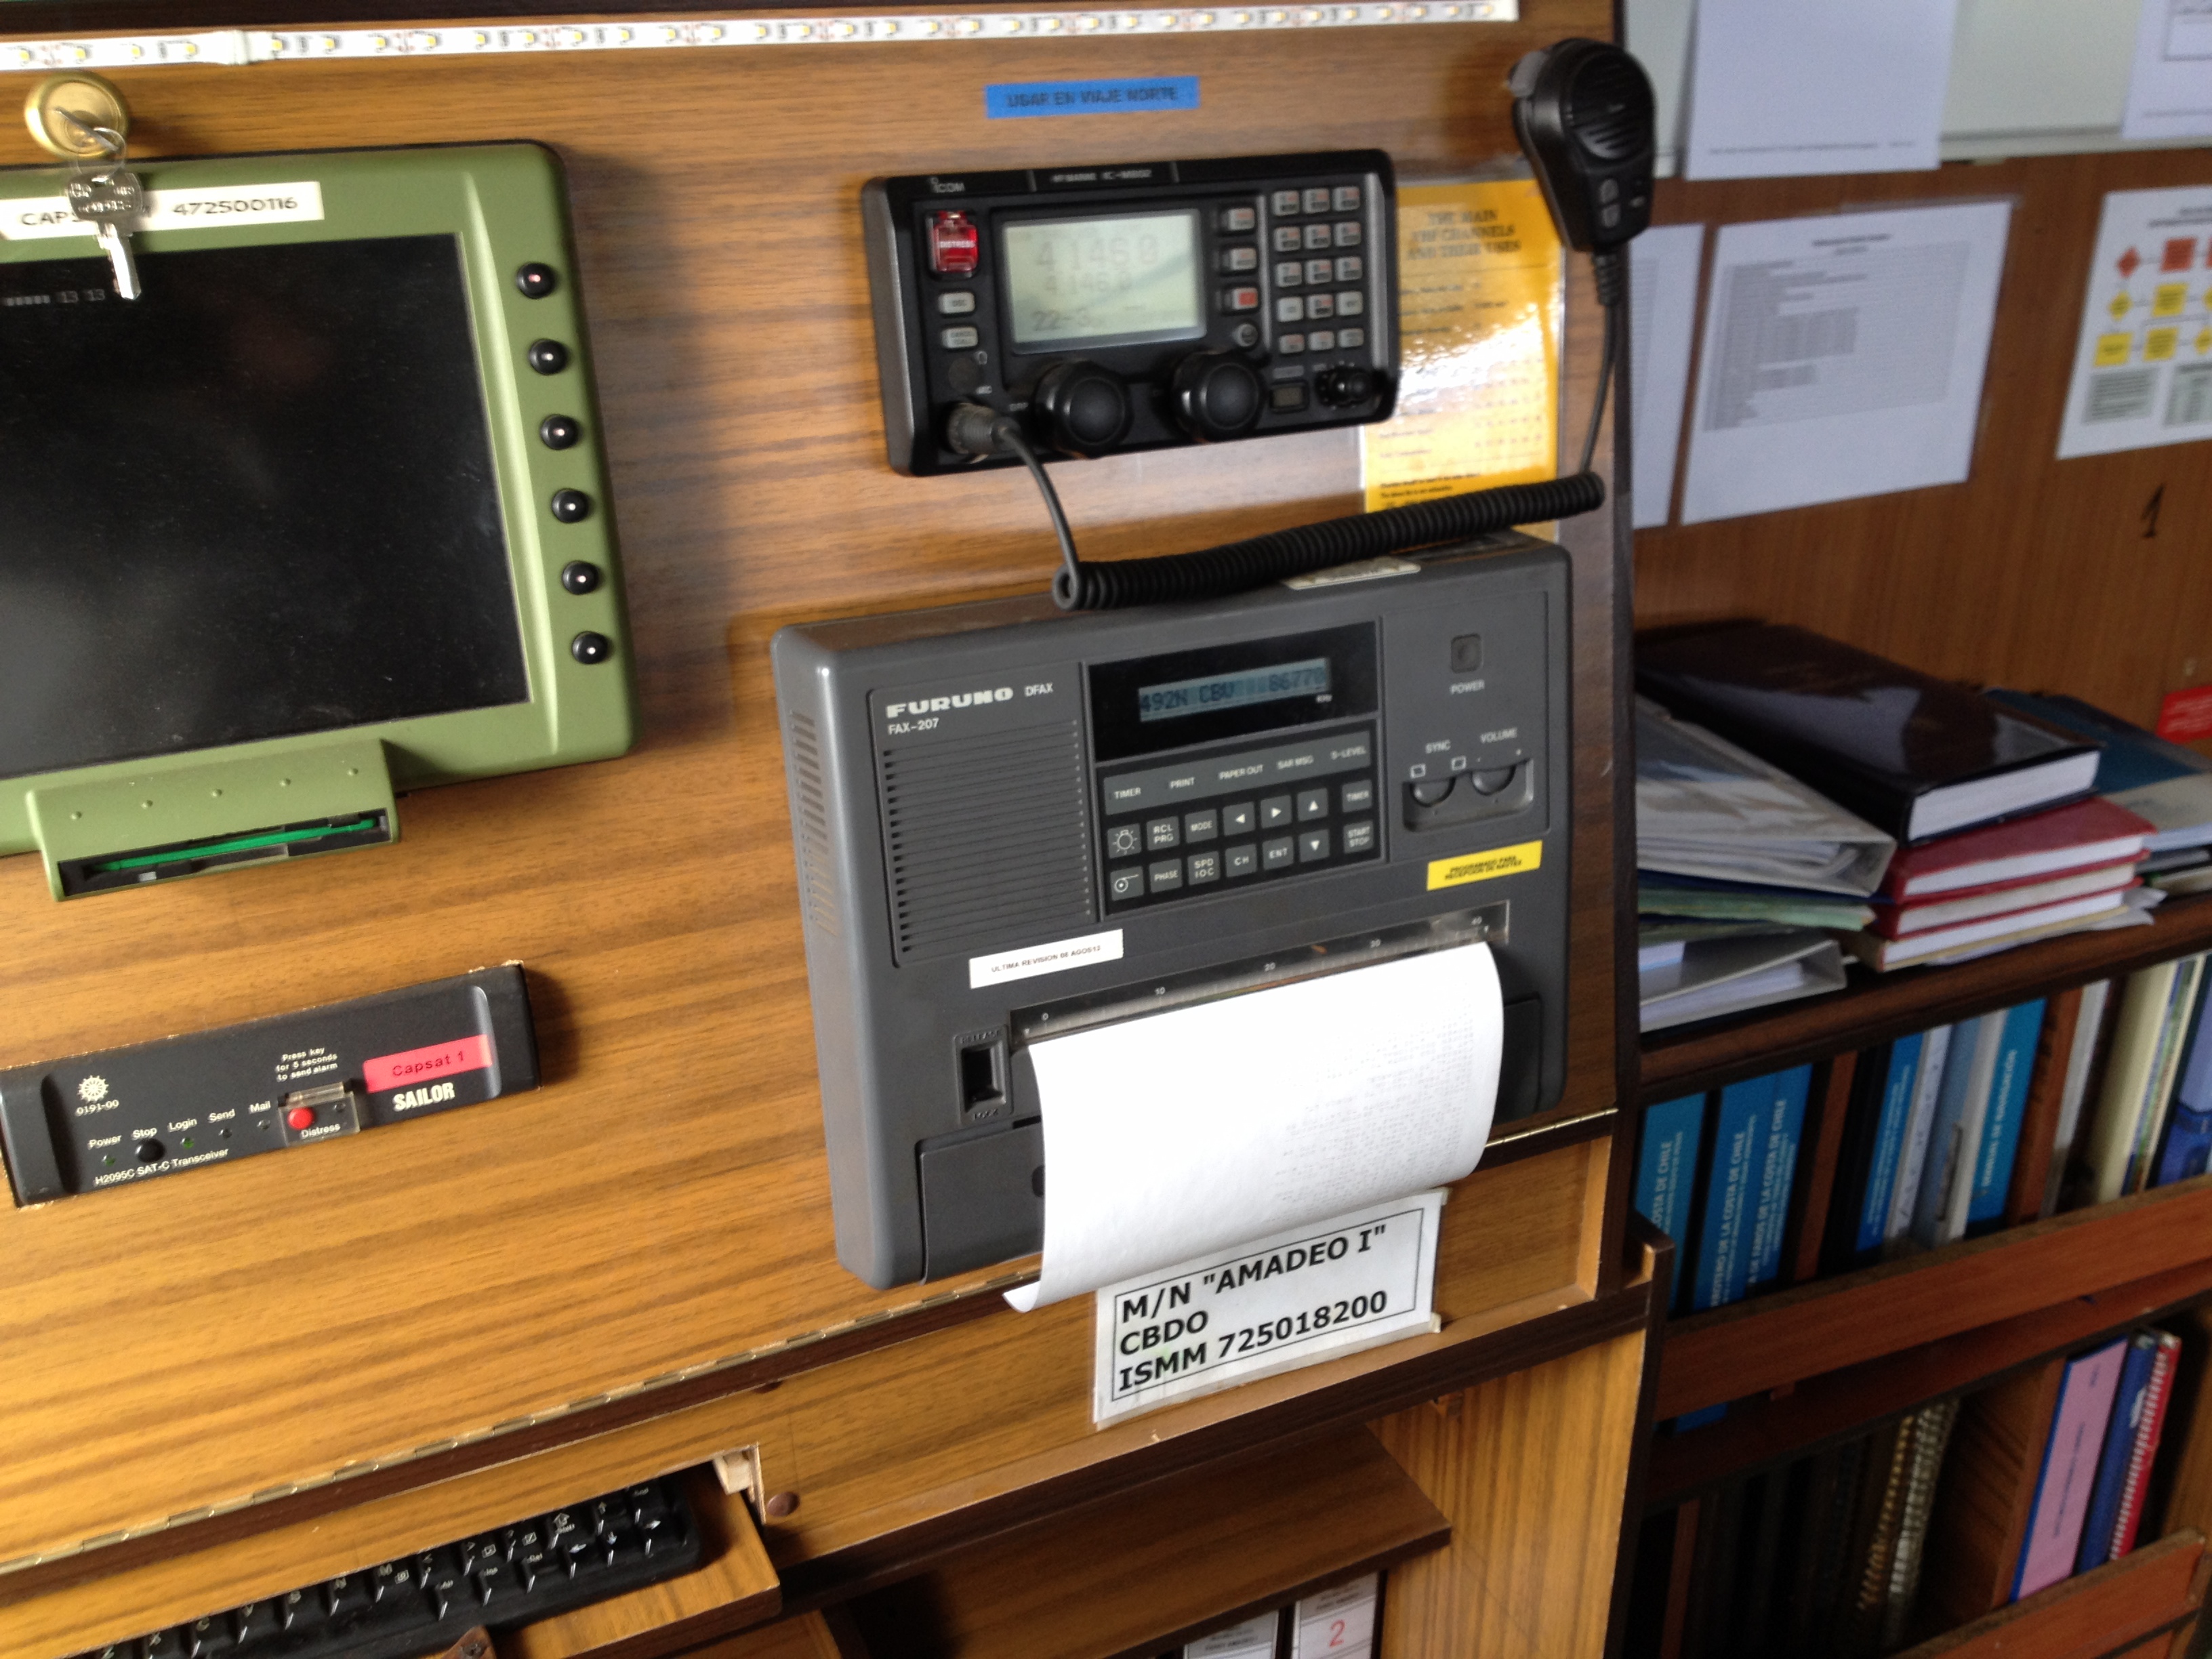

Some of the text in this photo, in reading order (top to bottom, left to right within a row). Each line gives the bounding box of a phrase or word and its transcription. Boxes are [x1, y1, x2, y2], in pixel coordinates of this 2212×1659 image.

[173, 197, 300, 216] 472500116
[1450, 680, 1485, 695] POWER
[885, 682, 1054, 718] FURUNO DFAX
[888, 718, 939, 735] FAX-207
[1480, 726, 1517, 743] VOLUME
[1330, 745, 1367, 760] S-LEVEL
[1426, 740, 1451, 754] SYNC
[1277, 756, 1314, 770] SAR MSG
[1219, 764, 1263, 780] PAPER OUT
[1169, 777, 1195, 790] PRINT
[1113, 787, 1141, 799] TIMER
[1347, 791, 1370, 802] TIMER
[1153, 824, 1173, 834] RCL
[1190, 821, 1213, 832] MODE
[1348, 826, 1370, 838] START
[1154, 833, 1174, 843] PRG
[1349, 836, 1370, 848] STOP
[1233, 856, 1249, 865] CH
[1269, 848, 1288, 859] ENT
[1194, 858, 1214, 869] SPD
[1154, 870, 1179, 881] PHASE
[1195, 867, 1214, 878] IOC
[1370, 939, 1381, 948] 30
[991, 962, 1020, 972] ULTIMA
[1021, 954, 1059, 966] REVISION
[1264, 962, 1275, 972] 20
[1155, 986, 1166, 995] 10
[282, 1046, 325, 1062] Press key
[275, 1063, 289, 1073] for
[302, 1053, 338, 1067] seconds
[392, 1051, 464, 1077] Capsat 1
[276, 1063, 338, 1082] to send alarm
[392, 1082, 456, 1111] SAILOR
[75, 1099, 119, 1117] 0191-00
[248, 1101, 271, 1113] Mail
[208, 1109, 236, 1123] Send
[167, 1118, 198, 1132] Login
[301, 1122, 341, 1140] Distress
[131, 1127, 157, 1141] Stop
[87, 1134, 122, 1150] Power
[1763, 1151, 1778, 1187] COSTA
[1771, 1099, 1787, 1132] CHILE
[1658, 1140, 1673, 1174] CHILE
[94, 1148, 229, 1186] H2095C SAT-C Transceiver
[1722, 1184, 1737, 1220] COSTA
[1731, 1132, 1746, 1165] CHILE
[1122, 1224, 1387, 1324] M/N "AMADEO I"
[1120, 1311, 1209, 1355] CBDO
[1118, 1290, 1388, 1392] ISMM 725018200
[1330, 1620, 1346, 1647] 2
